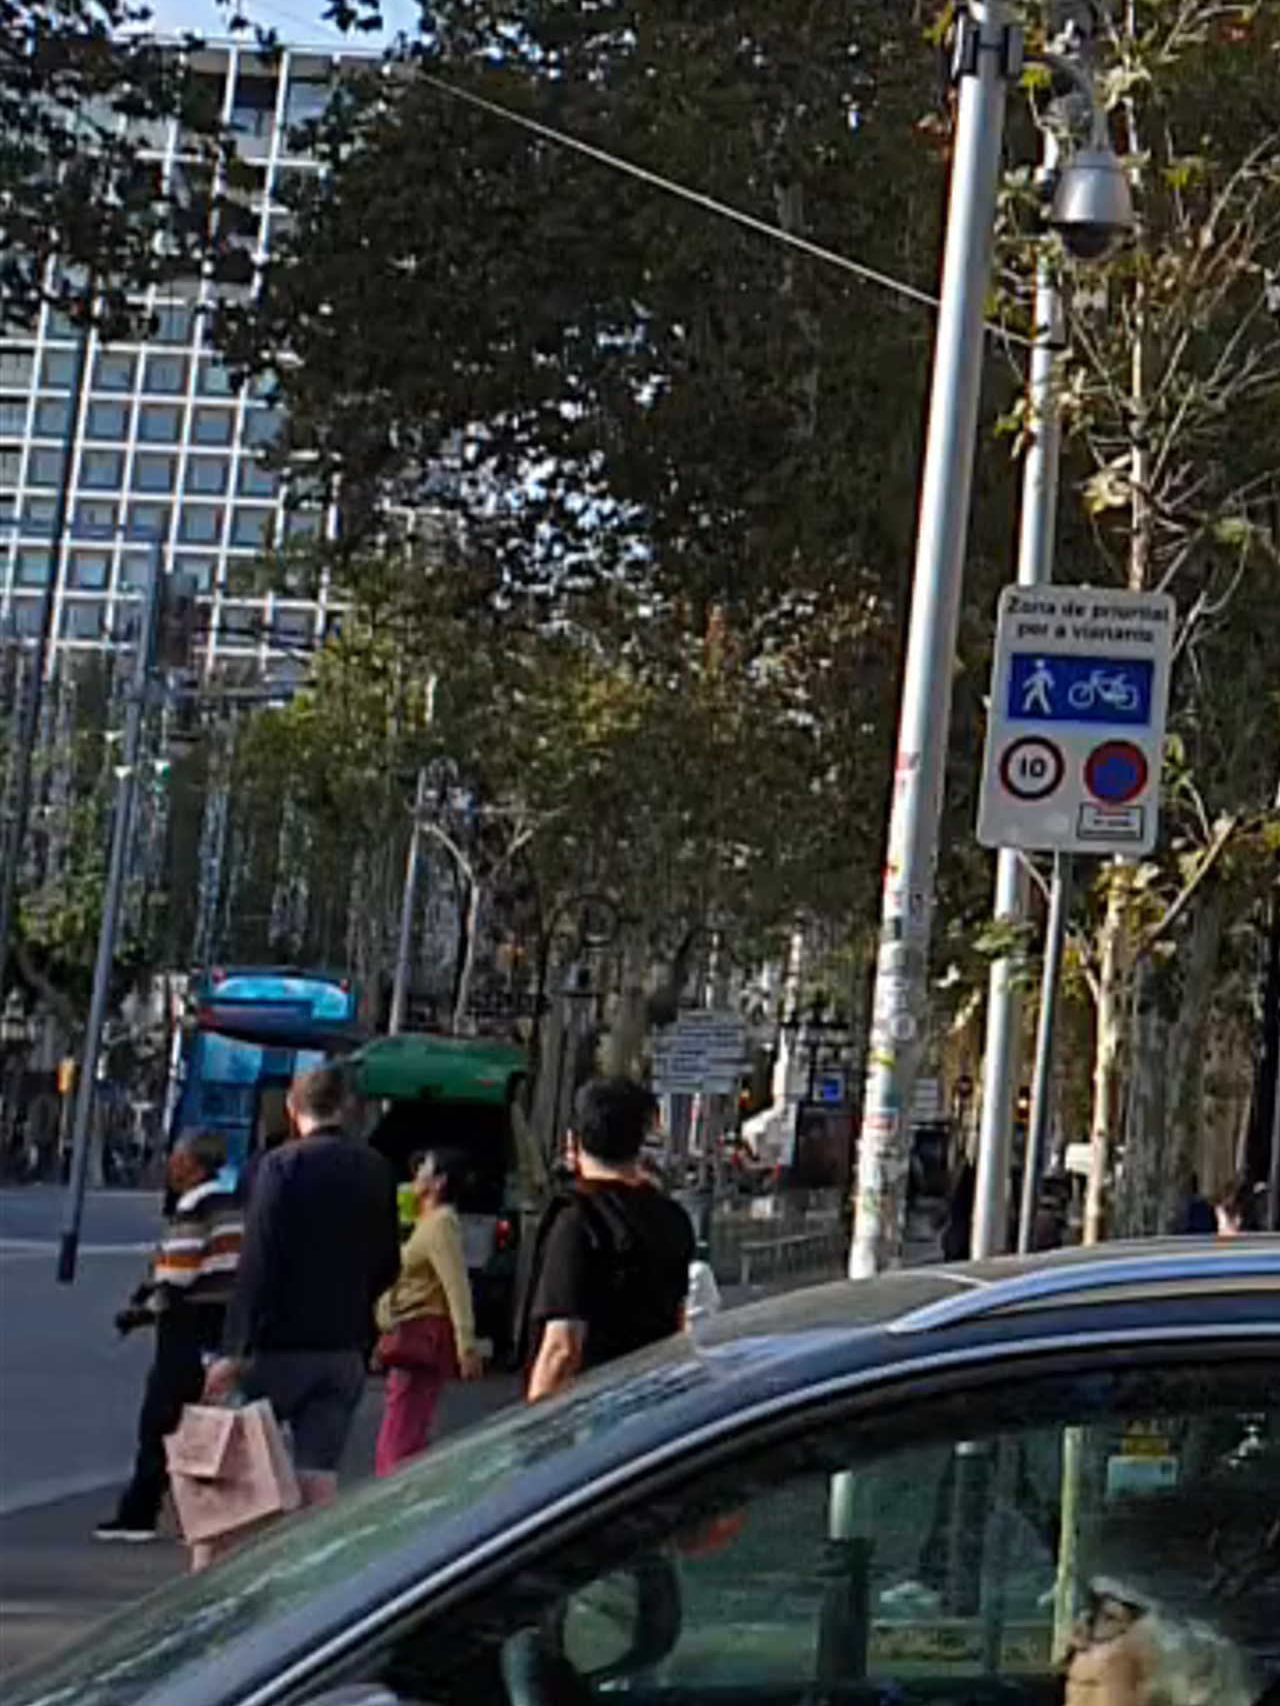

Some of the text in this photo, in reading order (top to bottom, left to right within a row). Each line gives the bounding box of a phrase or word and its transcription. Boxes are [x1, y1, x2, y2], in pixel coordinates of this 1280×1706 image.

[1007, 595, 1055, 615] Zona
[1061, 601, 1086, 617] de
[1018, 754, 1047, 778] 10
